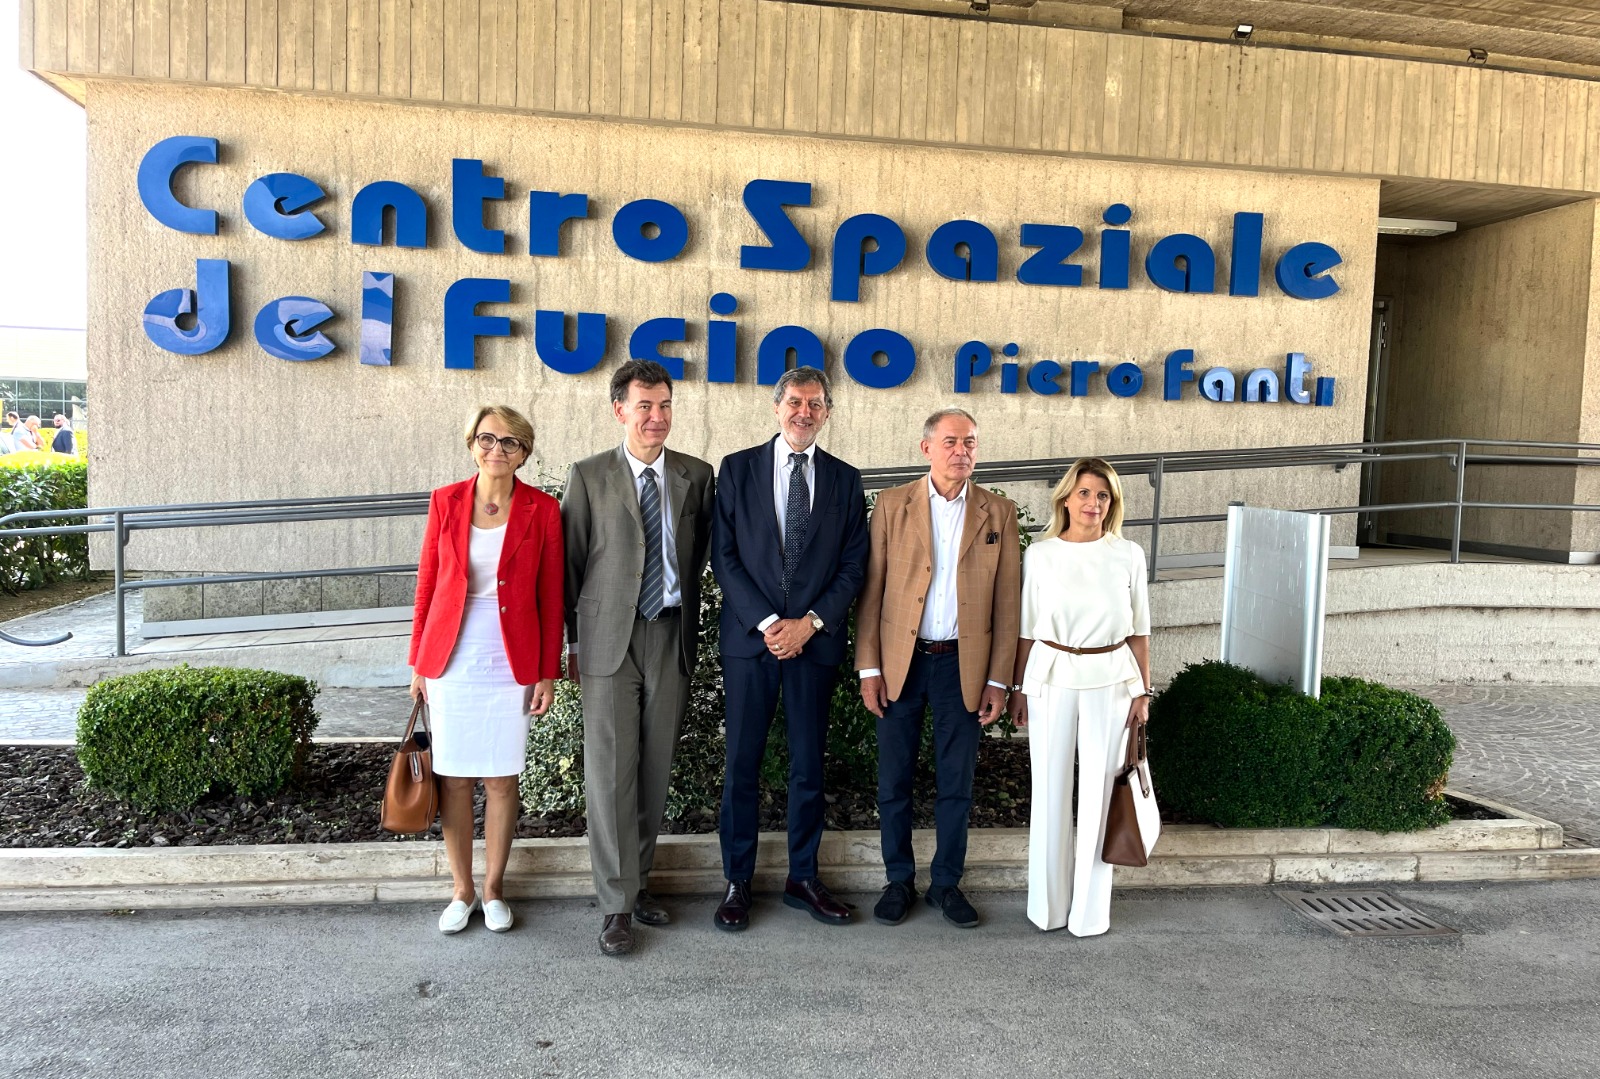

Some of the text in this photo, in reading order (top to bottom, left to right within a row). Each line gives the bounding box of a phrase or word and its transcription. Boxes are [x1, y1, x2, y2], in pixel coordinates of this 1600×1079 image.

[137, 136, 1343, 303] Centro Spaziale
[143, 259, 395, 366] del
[444, 278, 917, 390] Fucino
[954, 340, 1144, 398] Piero
